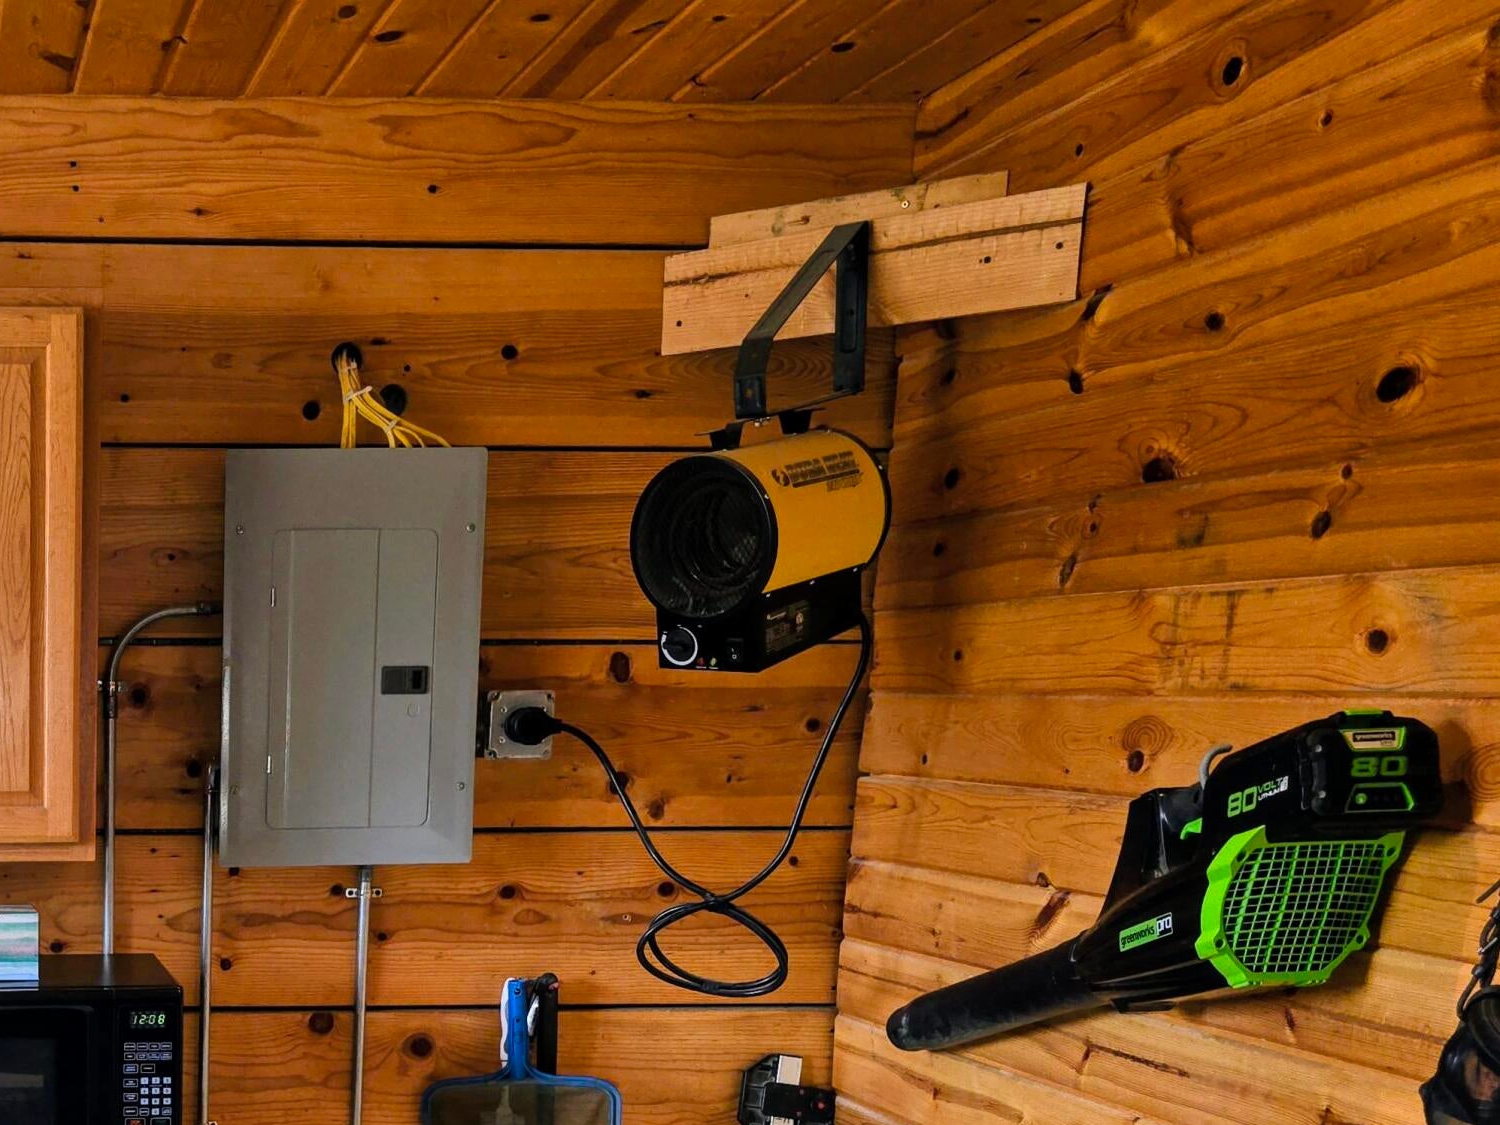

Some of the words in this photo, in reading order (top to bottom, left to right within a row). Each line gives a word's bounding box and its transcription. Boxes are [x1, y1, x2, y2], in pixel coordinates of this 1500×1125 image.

[1351, 756, 1408, 777] 80
[1228, 786, 1257, 818] 80
[1258, 777, 1283, 793] VOLT
[1121, 925, 1155, 949] greenworks
[1156, 916, 1171, 936] pro
[133, 1014, 165, 1025] 12:08
